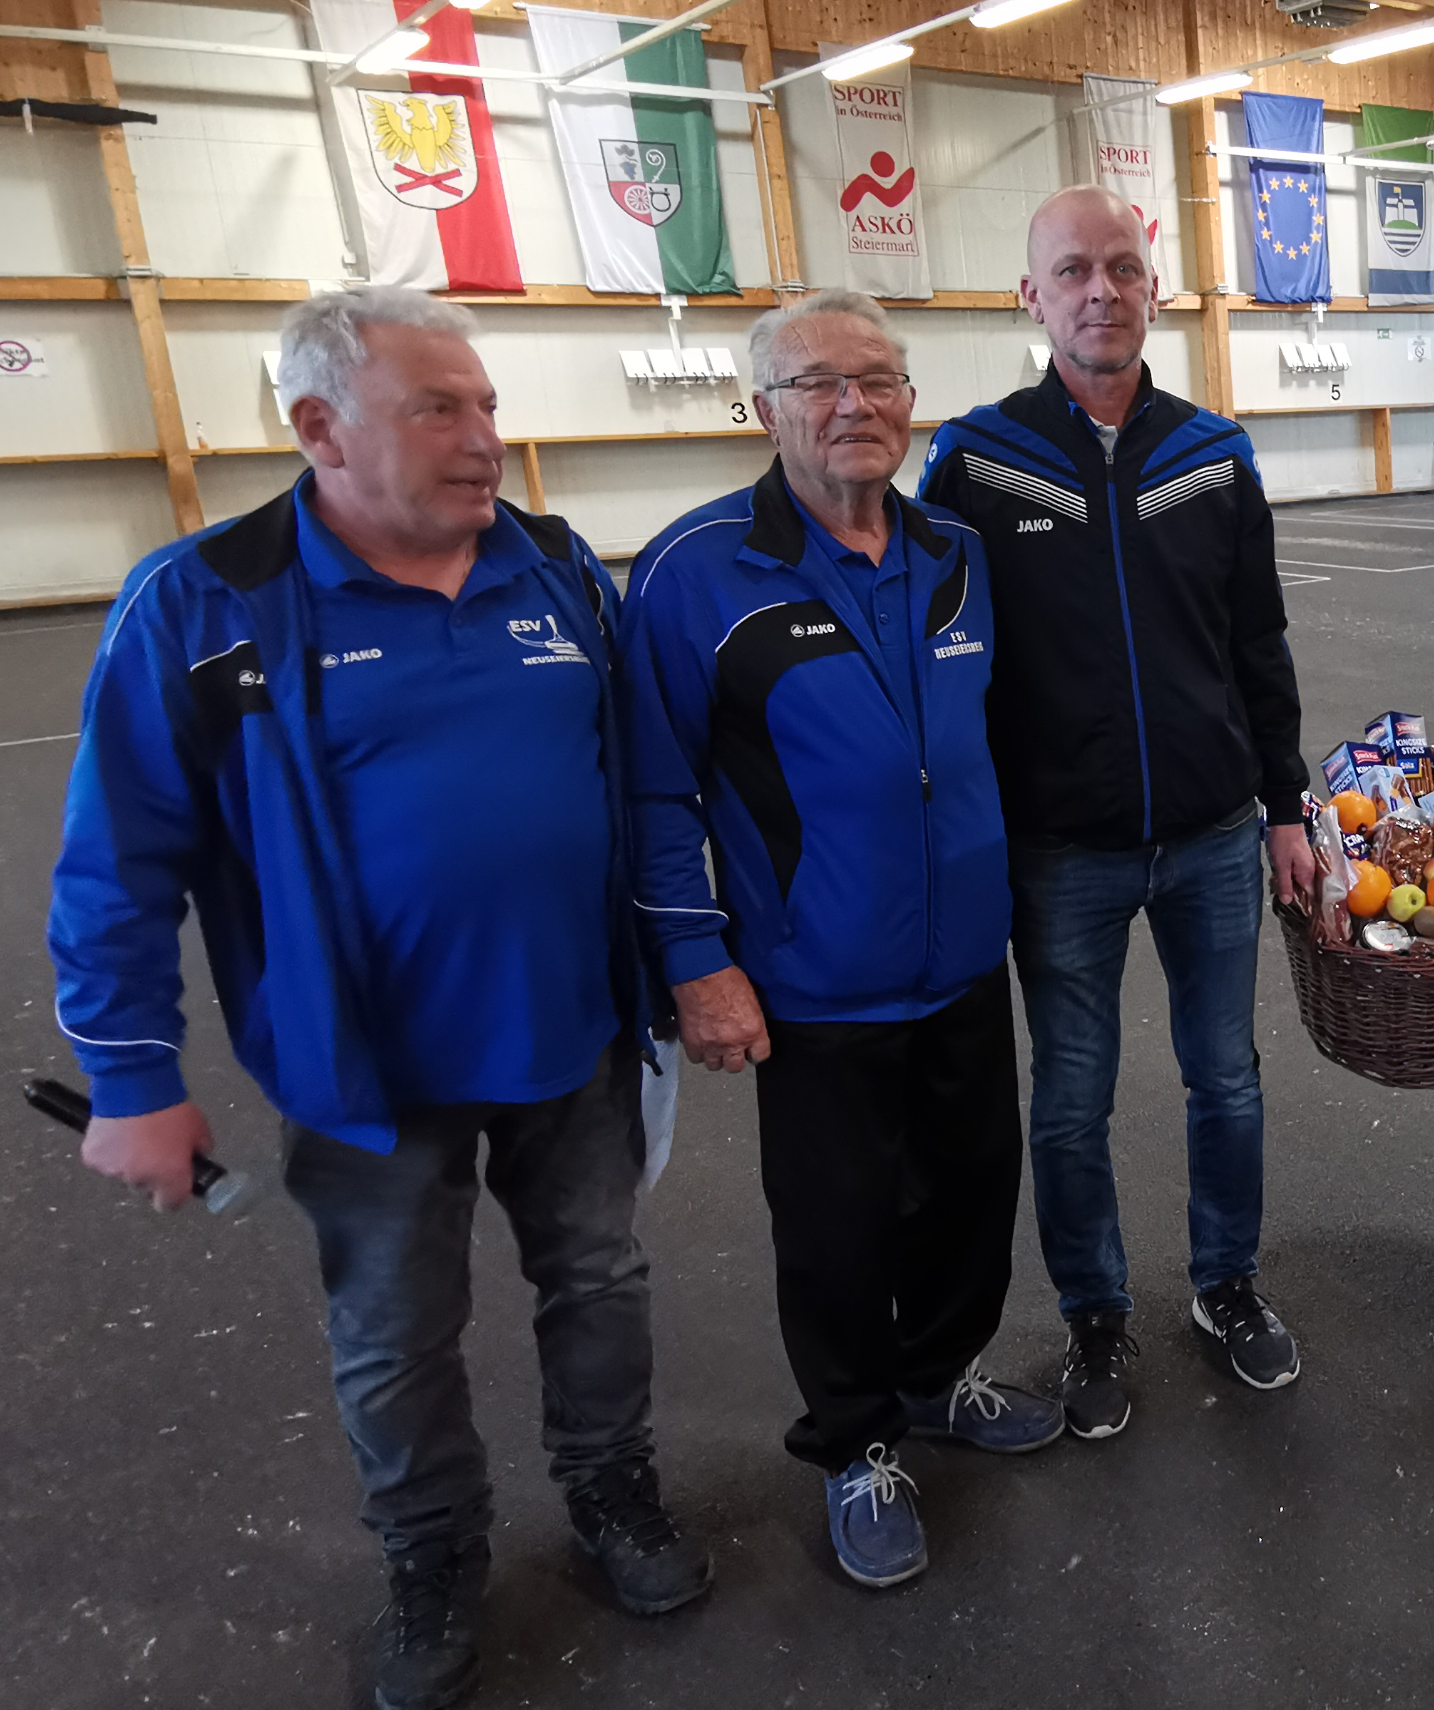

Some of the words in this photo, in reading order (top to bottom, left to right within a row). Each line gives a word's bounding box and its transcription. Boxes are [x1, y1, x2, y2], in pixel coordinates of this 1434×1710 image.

[834, 84, 902, 108] SPORT
[850, 104, 903, 122] Österreich
[1100, 146, 1150, 165] SPORT
[1109, 163, 1151, 178] Österreich
[851, 213, 914, 236] ASKÖ
[1331, 384, 1341, 400] 5
[731, 402, 748, 424] 3
[1017, 518, 1054, 533] JAKO
[509, 620, 541, 632] ESV
[806, 623, 836, 636] JAKO
[343, 648, 383, 664] JAKO
